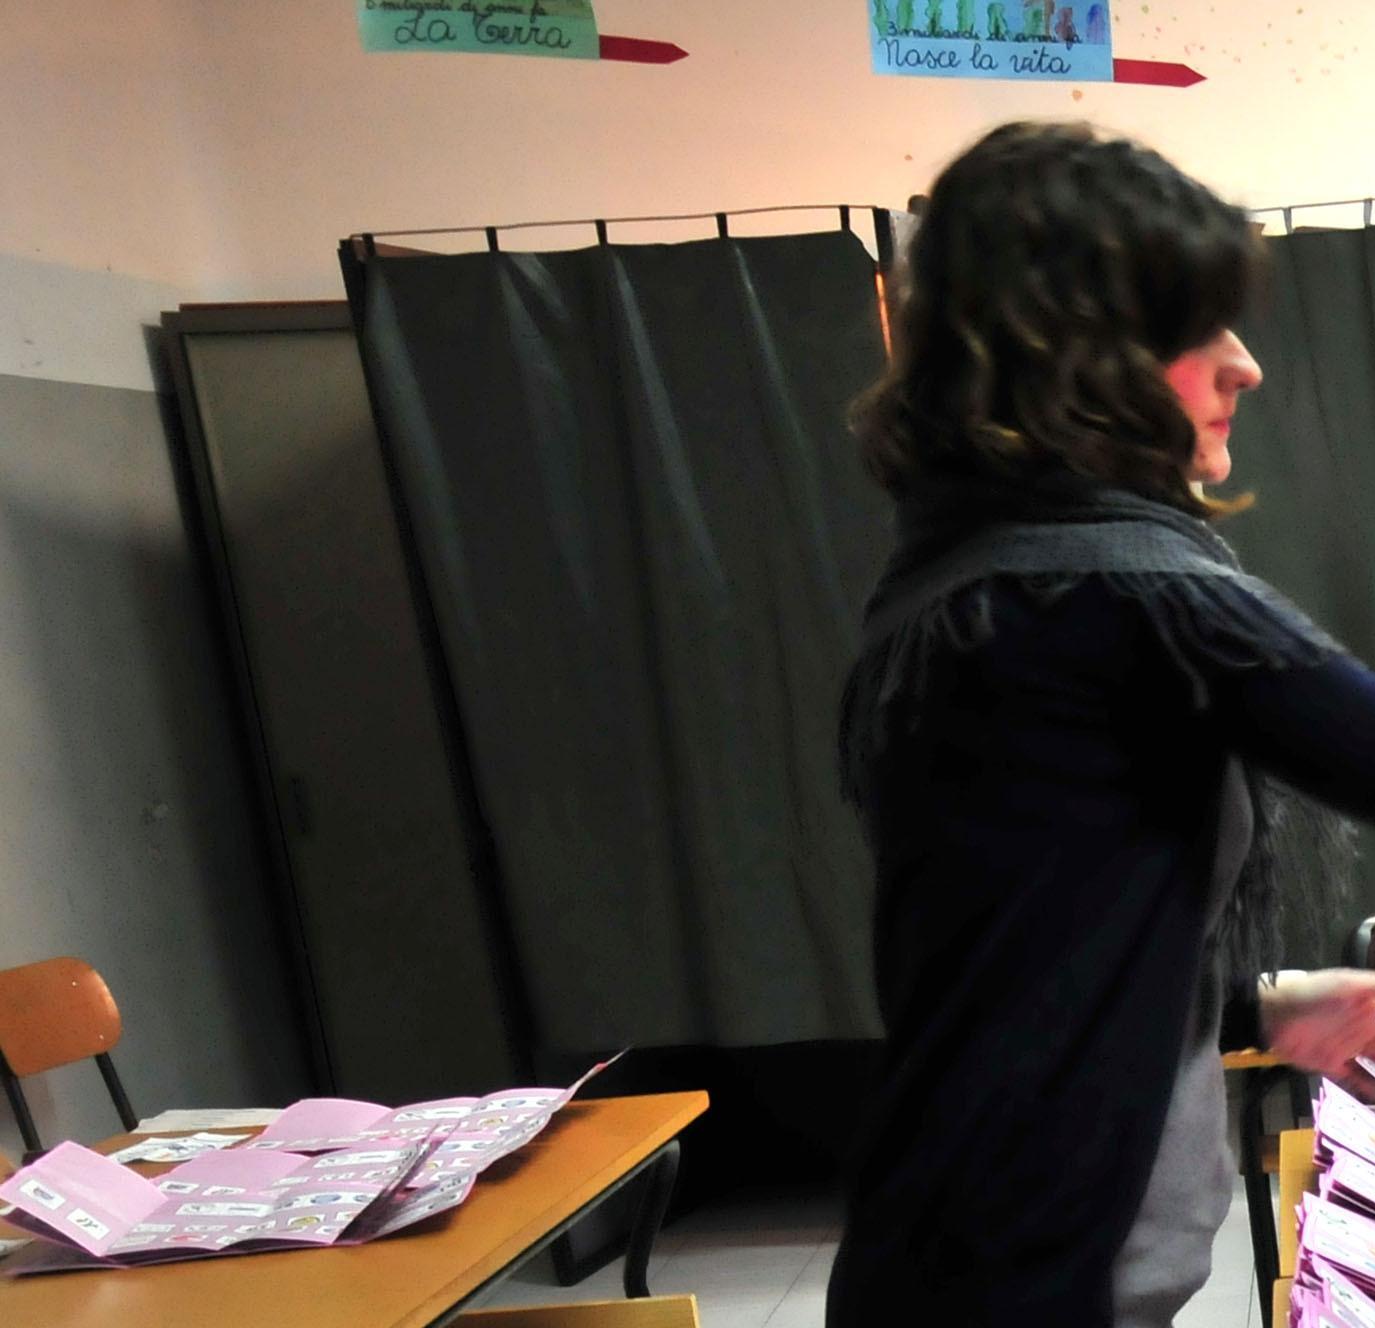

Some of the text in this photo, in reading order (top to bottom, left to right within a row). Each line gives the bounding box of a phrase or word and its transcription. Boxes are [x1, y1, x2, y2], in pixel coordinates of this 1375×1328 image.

[395, 13, 457, 44] La
[878, 38, 1073, 74] Nasce la vita
